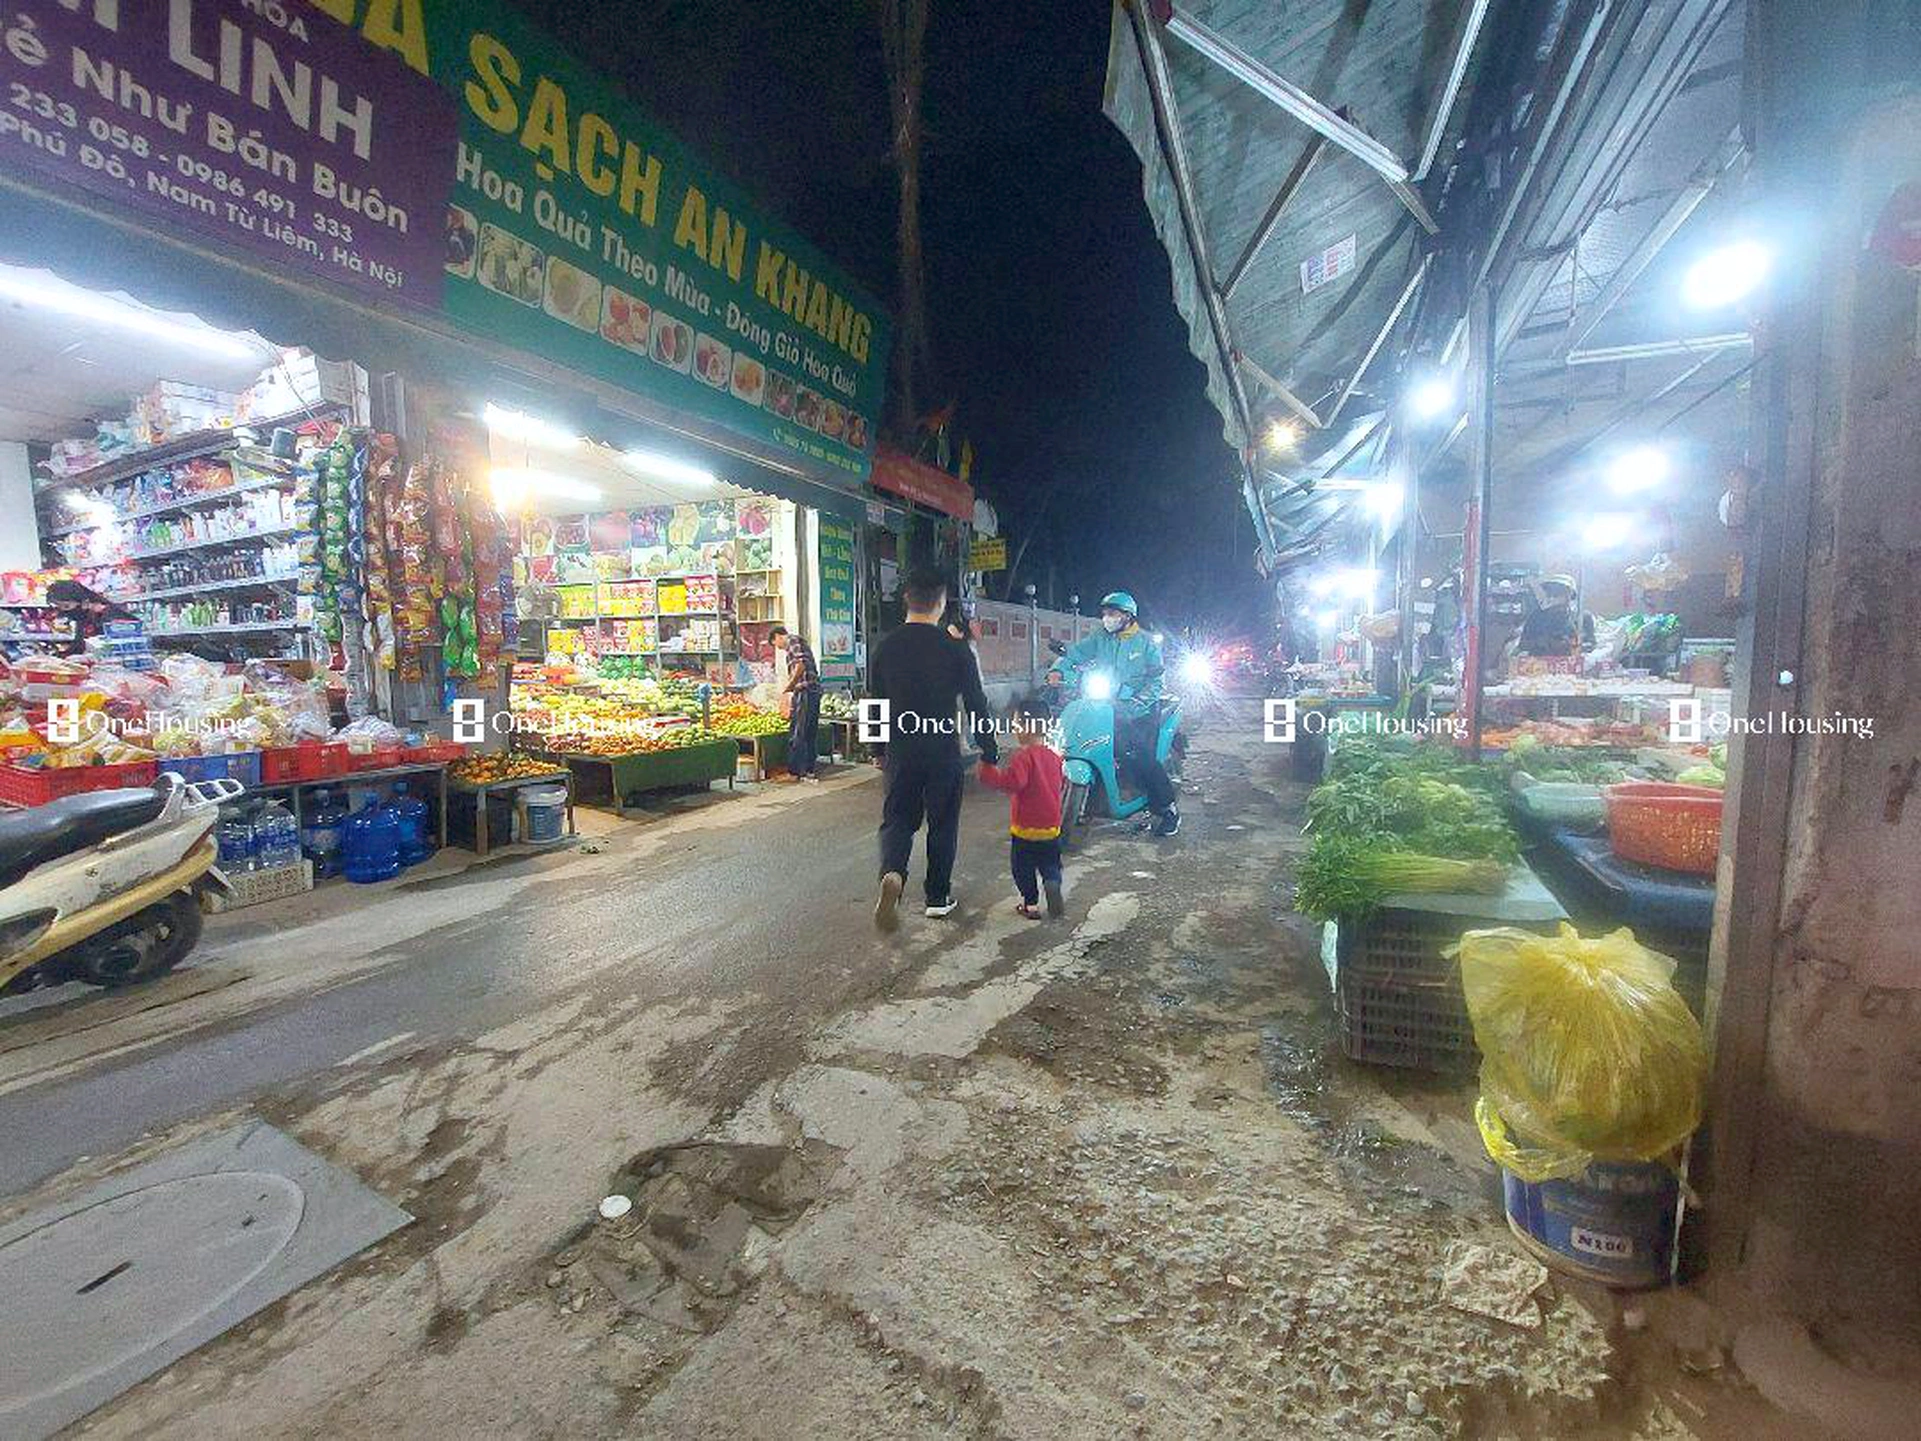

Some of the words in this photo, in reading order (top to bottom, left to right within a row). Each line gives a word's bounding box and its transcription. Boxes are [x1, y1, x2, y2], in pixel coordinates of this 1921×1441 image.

[10, 82, 78, 128] 233
[88, 116, 150, 159] 058
[176, 154, 246, 198] 0986
[254, 189, 296, 219] 491
[312, 213, 354, 243] 333
[72, 46, 193, 135] Như
[207, 111, 297, 183] Bán
[313, 163, 408, 233] Buôn
[168, 0, 373, 162] LINH
[147, 170, 216, 216] Nam
[263, 217, 325, 261] Liêm,
[332, 246, 363, 273] Hà
[369, 261, 403, 289] Nội
[456, 142, 524, 214] Hoa
[533, 189, 592, 250] Quả
[601, 225, 659, 287] Theo
[664, 262, 711, 317] Mùa
[802, 346, 830, 383] Hoa
[464, 31, 663, 228] SẠCH
[674, 184, 747, 283] AN
[755, 240, 872, 365] KHANG
